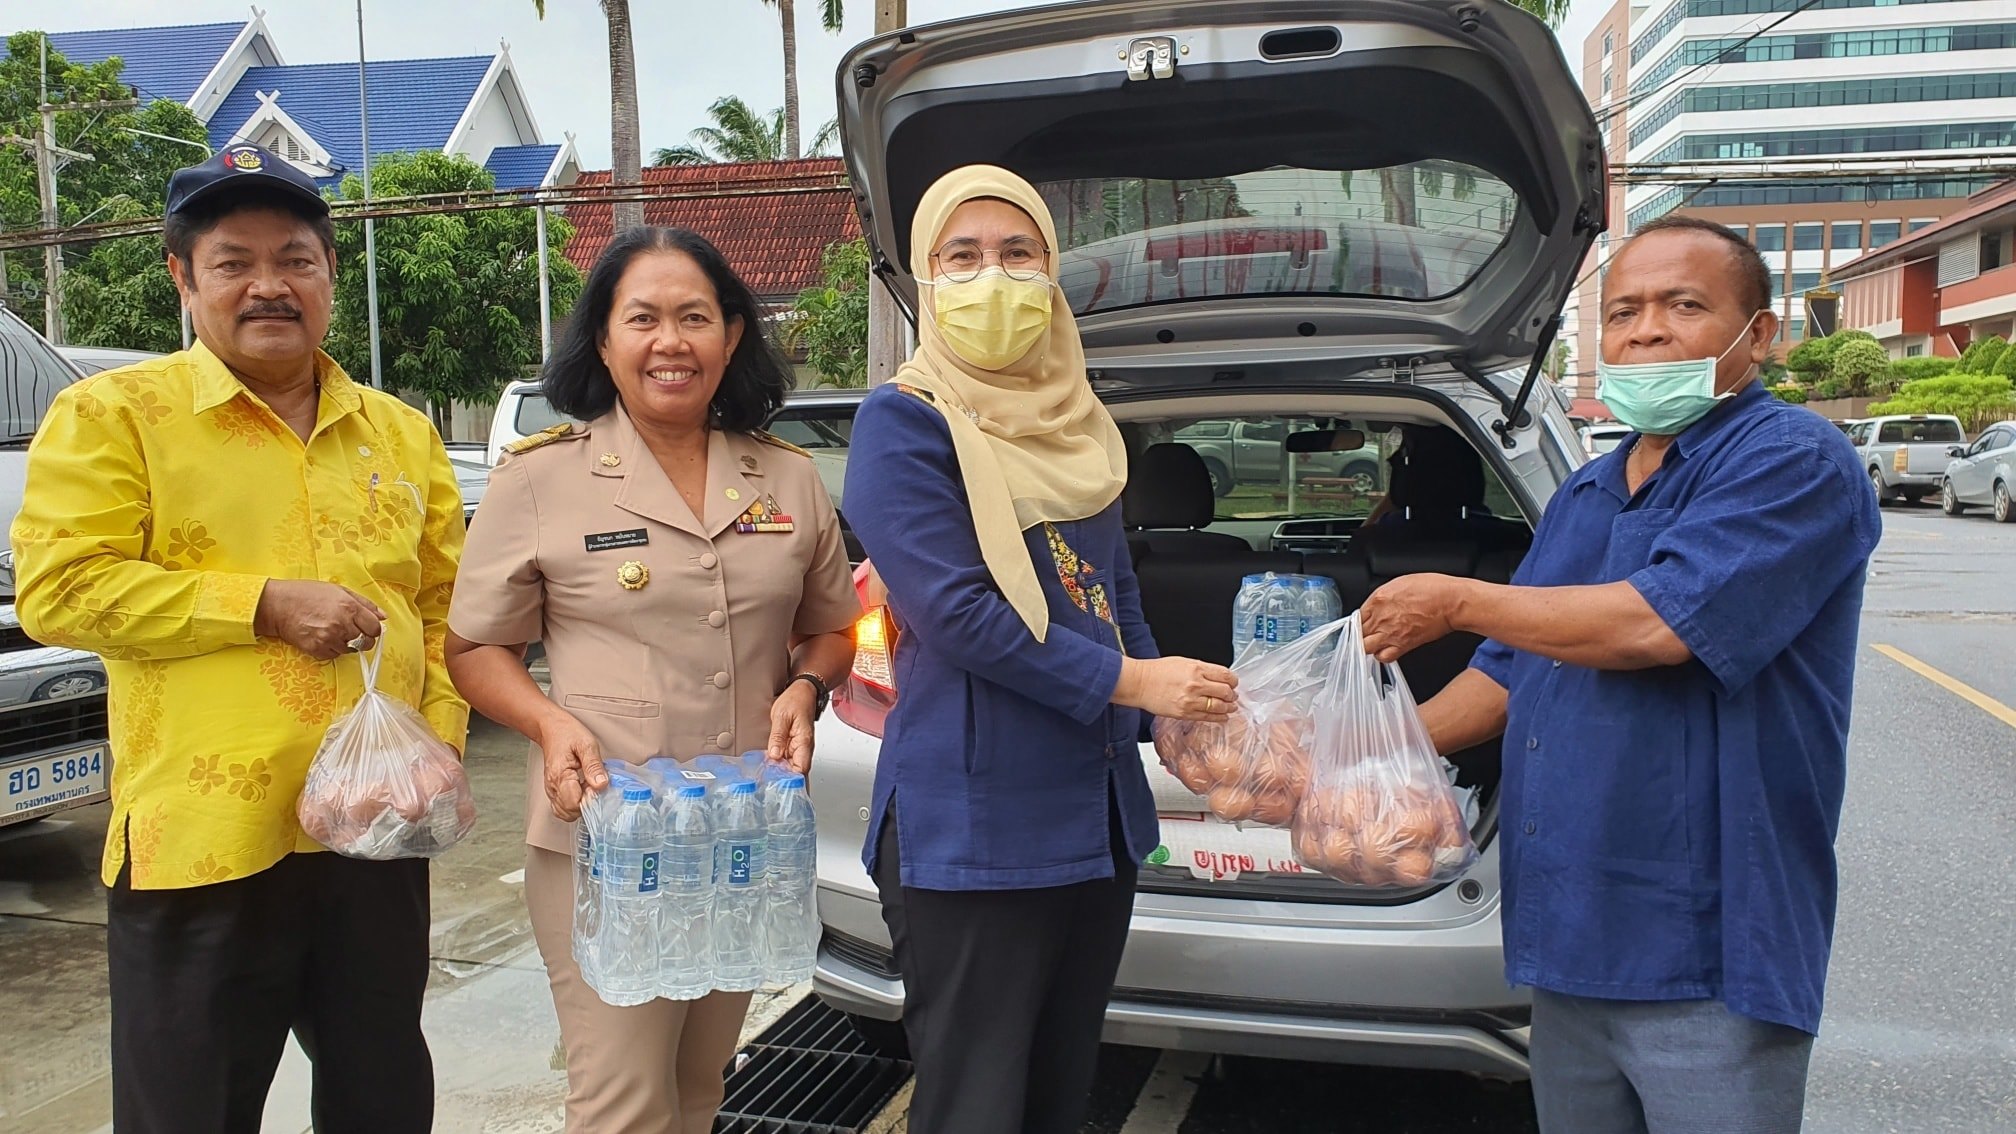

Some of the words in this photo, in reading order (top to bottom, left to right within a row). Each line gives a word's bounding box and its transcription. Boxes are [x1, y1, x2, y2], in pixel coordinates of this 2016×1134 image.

[52, 752, 101, 783] 5884
[15, 785, 90, 811] กรงเทพมหานคร
[644, 857, 658, 886] H2O
[733, 849, 750, 878] H2O
[1194, 850, 1255, 878] สมโอ
